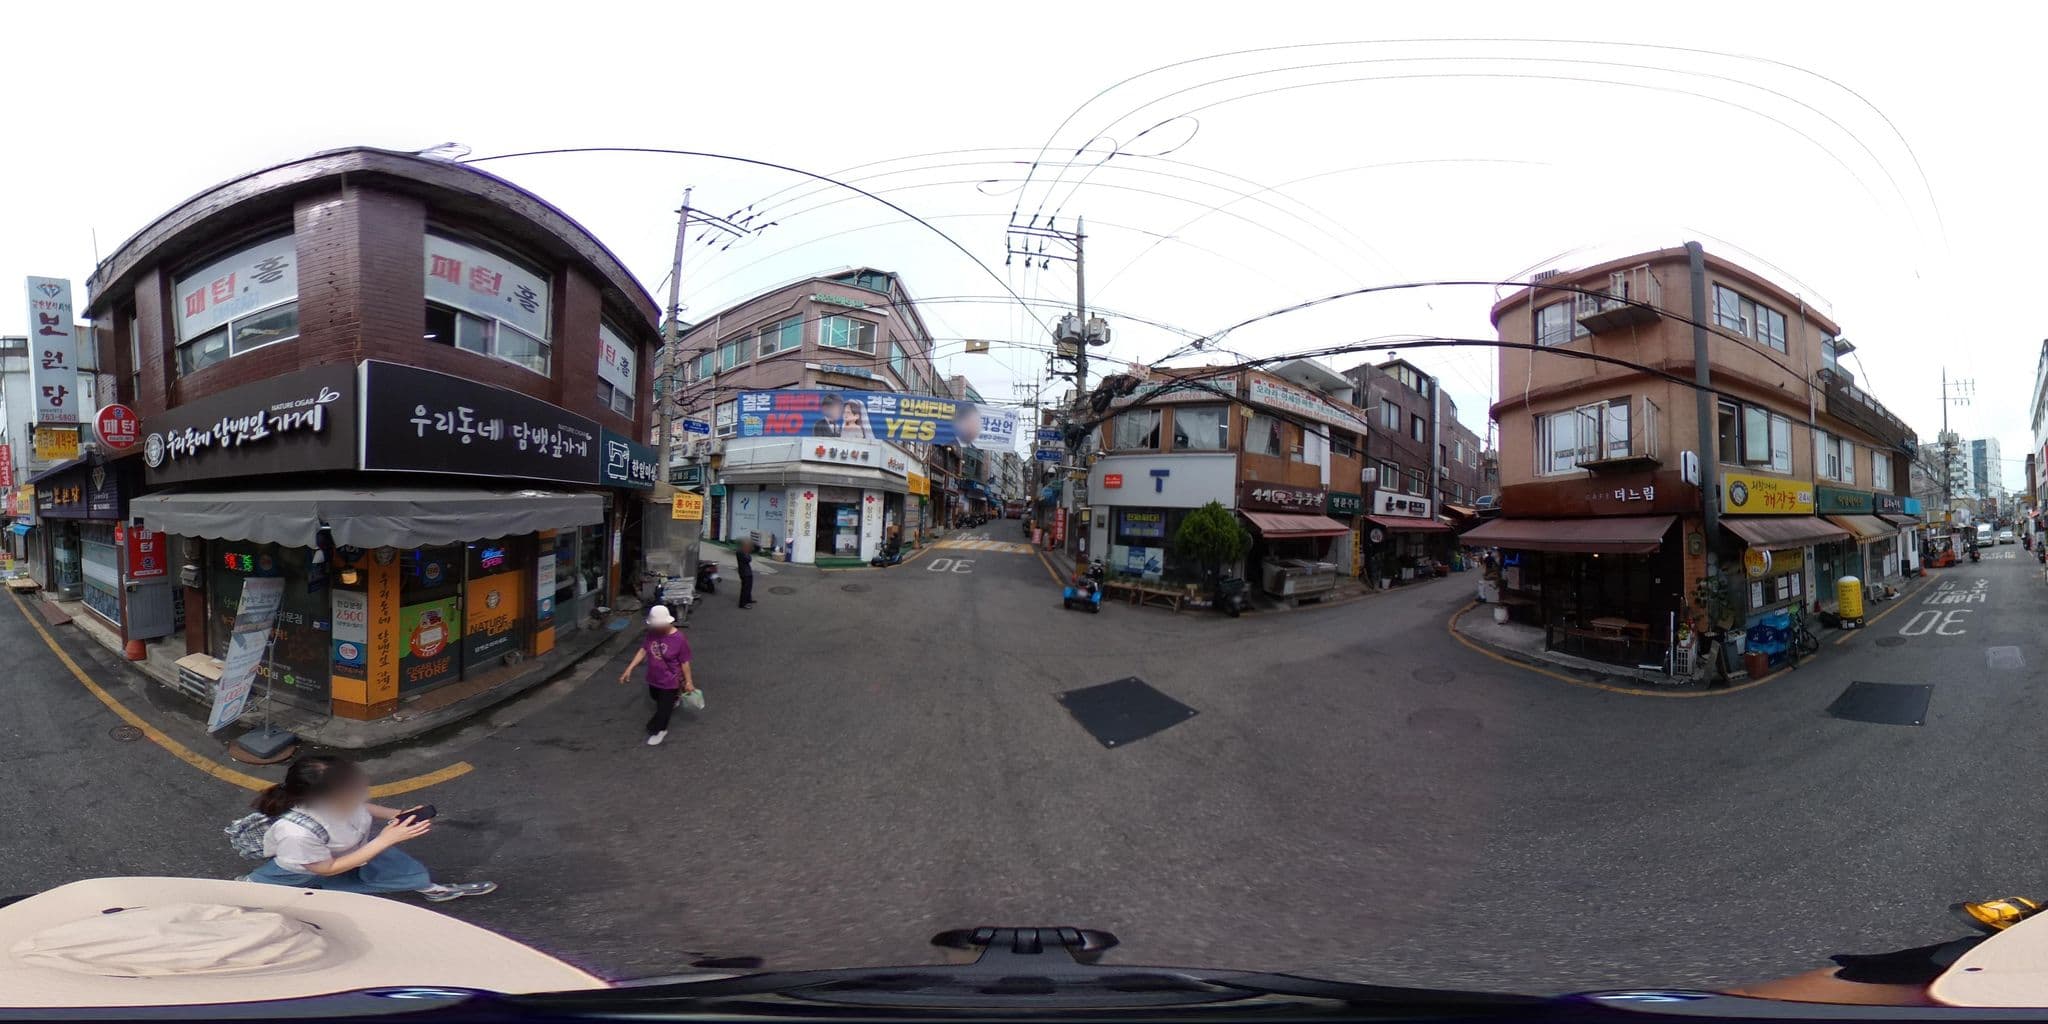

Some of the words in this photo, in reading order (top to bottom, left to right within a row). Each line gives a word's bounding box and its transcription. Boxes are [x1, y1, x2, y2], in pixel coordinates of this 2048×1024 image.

[38, 311, 70, 407] 보원당
[103, 419, 135, 434] 패턴
[410, 404, 504, 444] 우리동네
[512, 422, 563, 458] 담뱃잎
[563, 437, 588, 457] 가게
[764, 413, 804, 434] NO
[885, 417, 937, 441] YES
[1149, 469, 1170, 493] T
[1614, 485, 1654, 502] 더느림
[1898, 608, 1974, 636] 30
[410, 664, 450, 683] STORE
